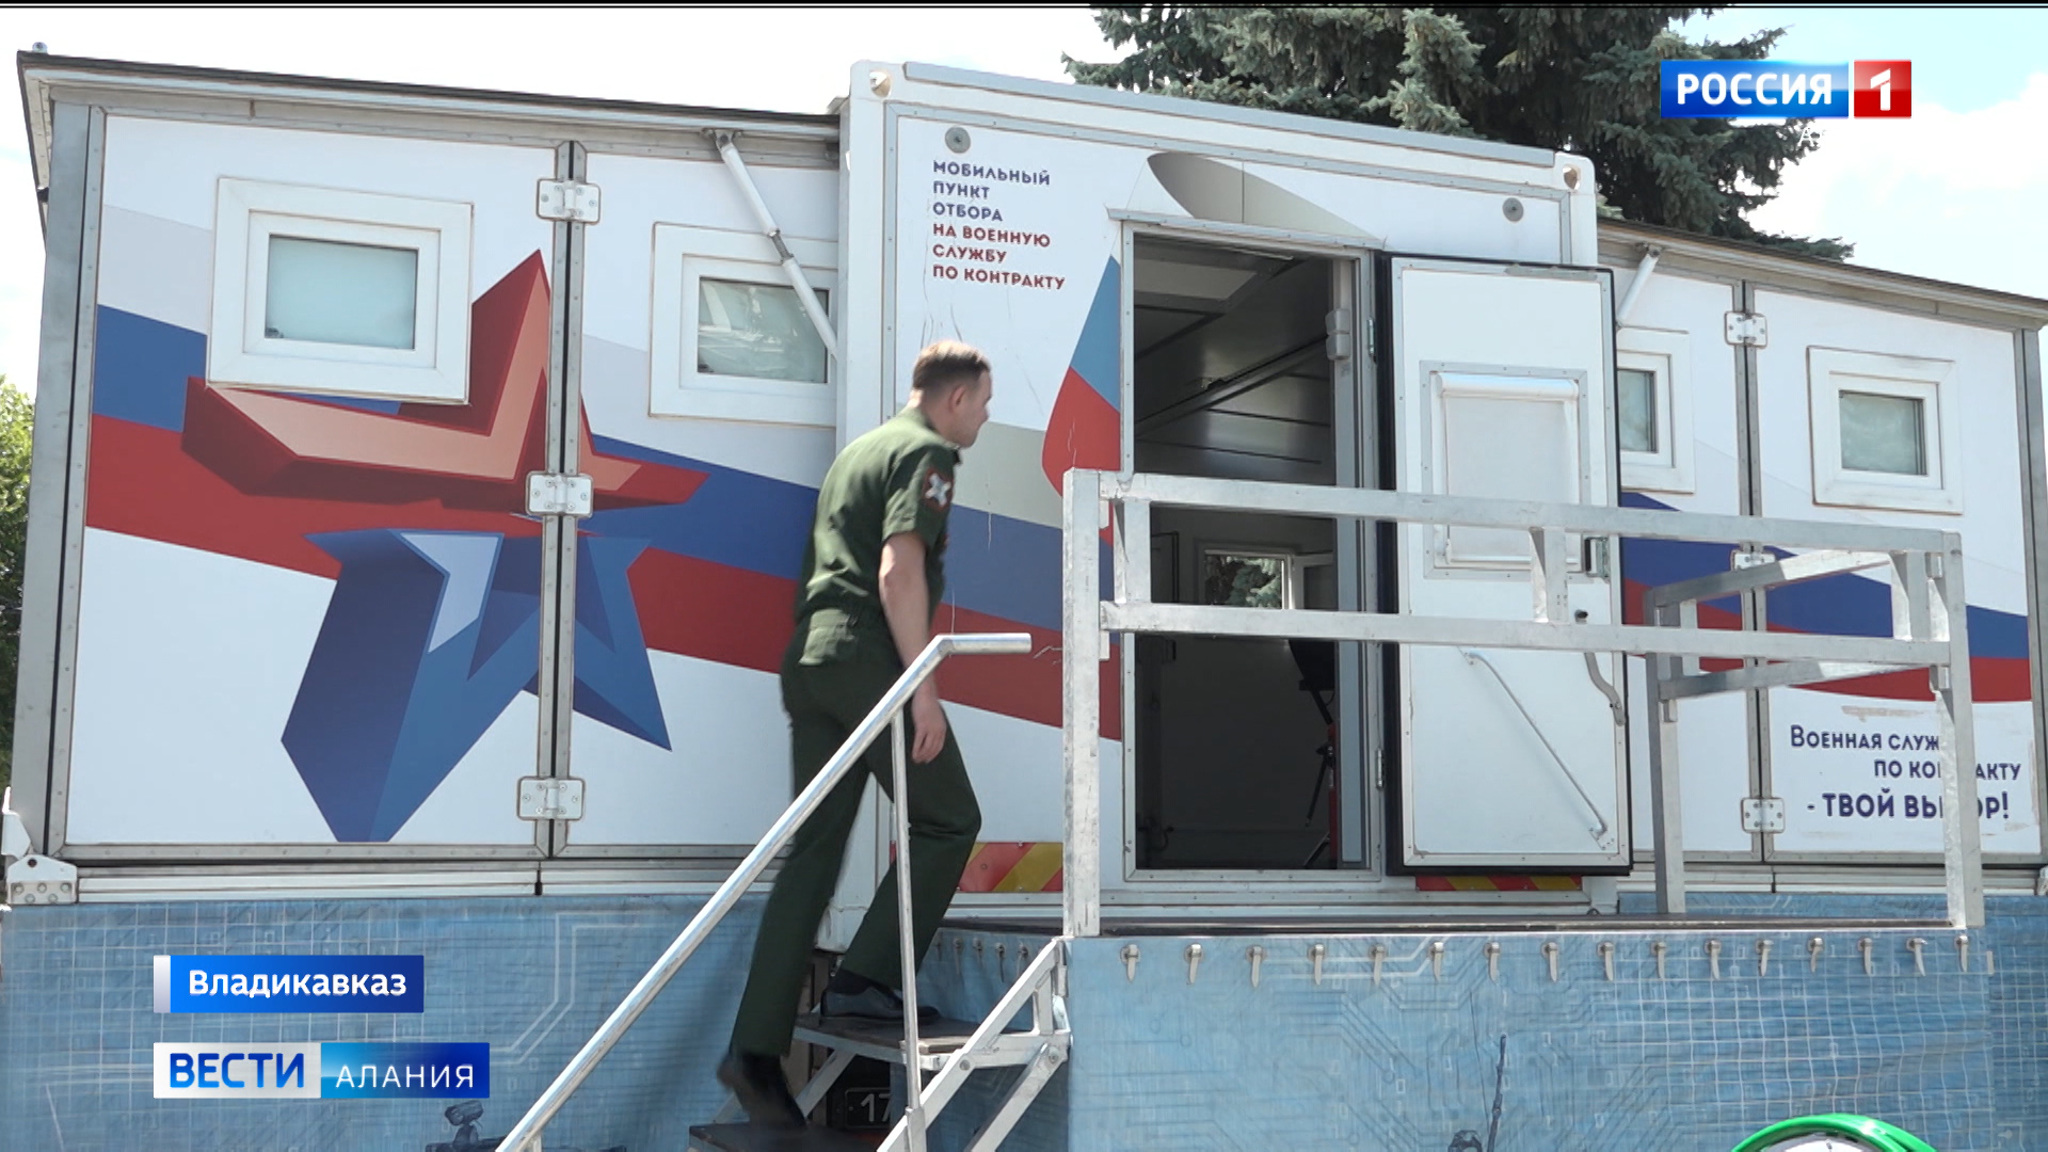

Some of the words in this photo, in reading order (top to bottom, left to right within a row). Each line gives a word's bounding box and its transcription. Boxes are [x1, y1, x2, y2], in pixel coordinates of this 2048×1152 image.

[933, 160, 1050, 185] МОБИЛЬНЫЙ
[933, 181, 990, 199] ПУНКТ
[933, 202, 1003, 221] ОТБОРА
[933, 223, 957, 238] НА
[963, 225, 1050, 247] ВОЕННУЮ
[932, 244, 1007, 264] СЛУЖБУ
[933, 264, 958, 279] ПО
[964, 268, 1065, 290] КОНТРАКТУ
[1888, 733, 1940, 751] СЛУЖ
[1874, 759, 1902, 778] ПО
[1822, 788, 1894, 817] ТВОЙ
